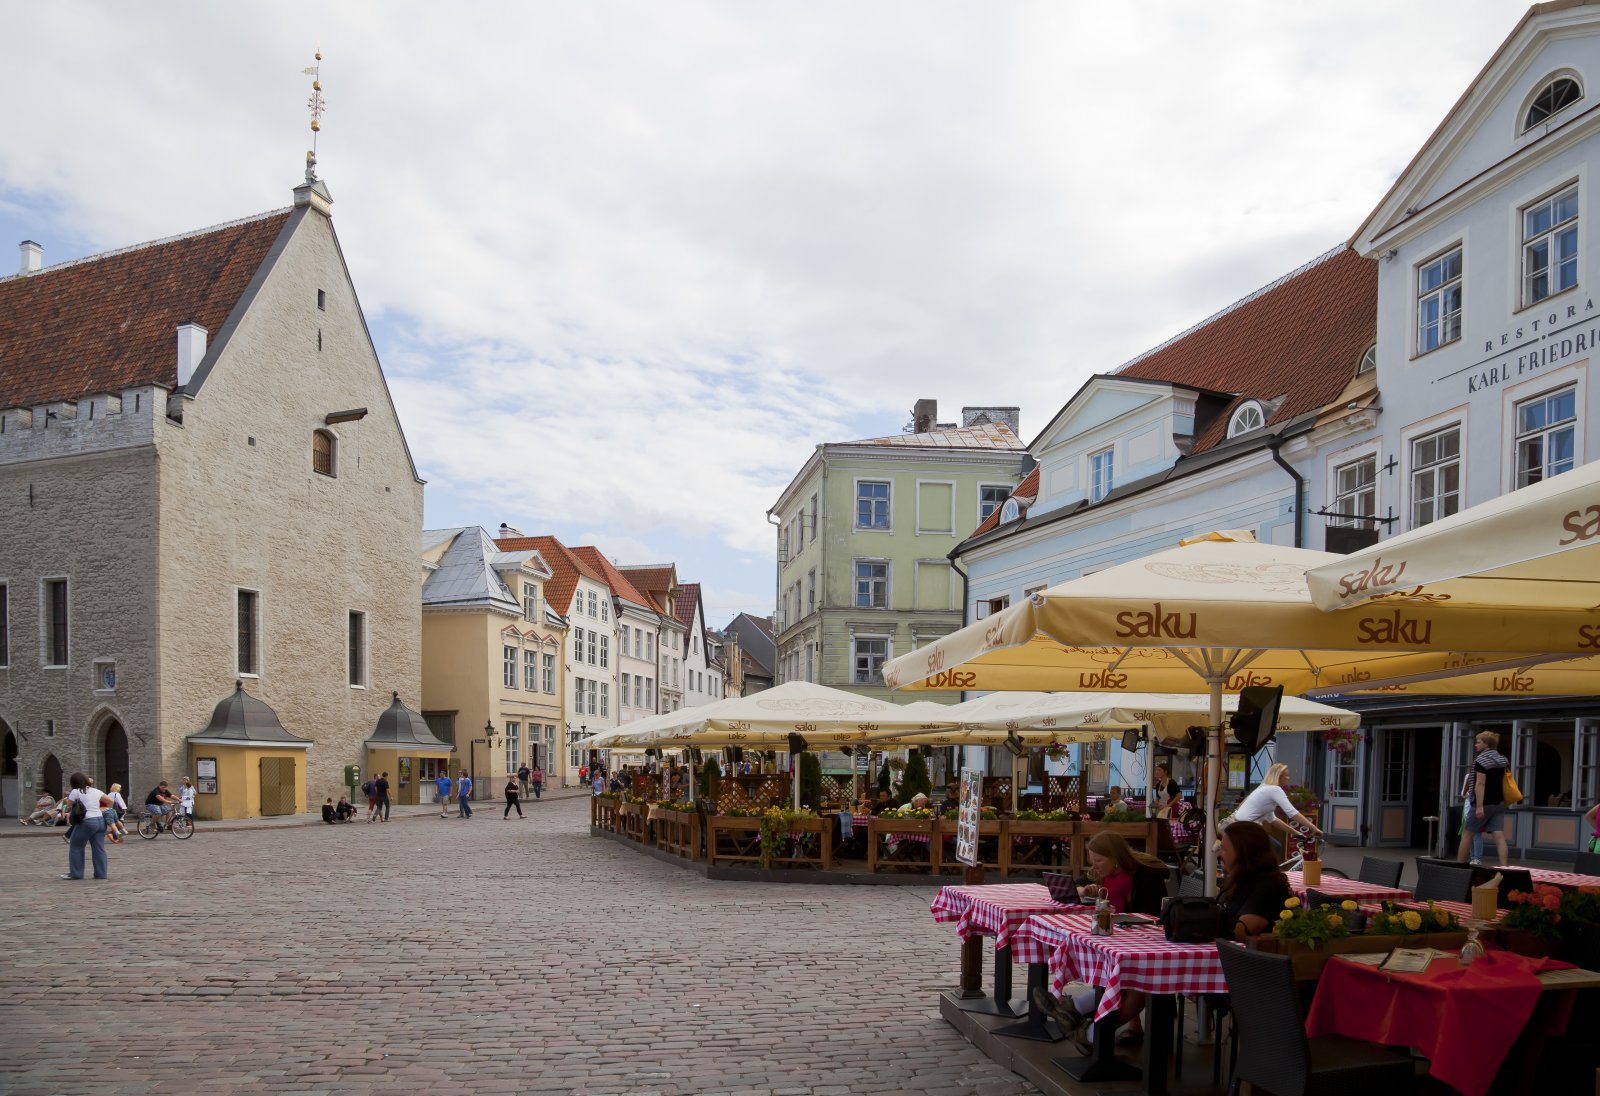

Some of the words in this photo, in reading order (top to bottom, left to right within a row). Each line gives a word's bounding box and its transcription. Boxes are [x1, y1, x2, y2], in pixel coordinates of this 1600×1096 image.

[1485, 298, 1594, 352] RESTORA
[1469, 364, 1509, 393] KARL
[1518, 328, 1600, 375] FRIEDRI
[1339, 557, 1407, 599] saku
[984, 617, 1004, 649] sak
[1116, 602, 1197, 639] saku
[1357, 609, 1432, 645] saku
[926, 646, 945, 674] saku
[728, 721, 751, 730] saku
[794, 722, 817, 732] saku
[857, 722, 879, 731] saku
[1043, 716, 1057, 727] saku
[1084, 712, 1099, 724] saku
[1320, 716, 1341, 727] saku
